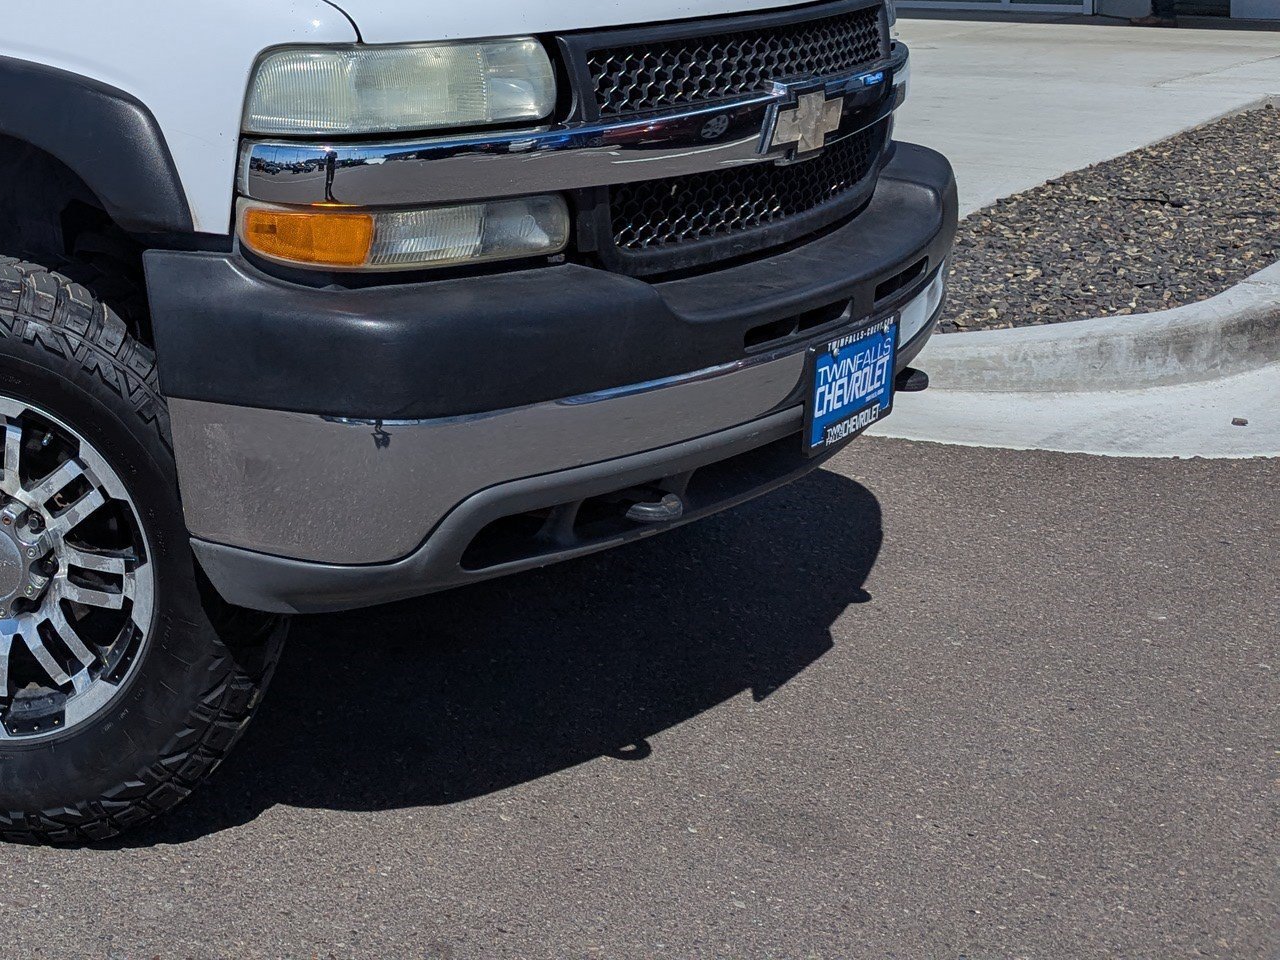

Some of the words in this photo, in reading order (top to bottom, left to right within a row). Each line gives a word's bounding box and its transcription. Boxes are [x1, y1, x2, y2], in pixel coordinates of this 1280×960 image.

[818, 337, 892, 386] TWINFALLS
[814, 355, 890, 418] CHEVROLET
[842, 403, 880, 437] CHEVROLET
